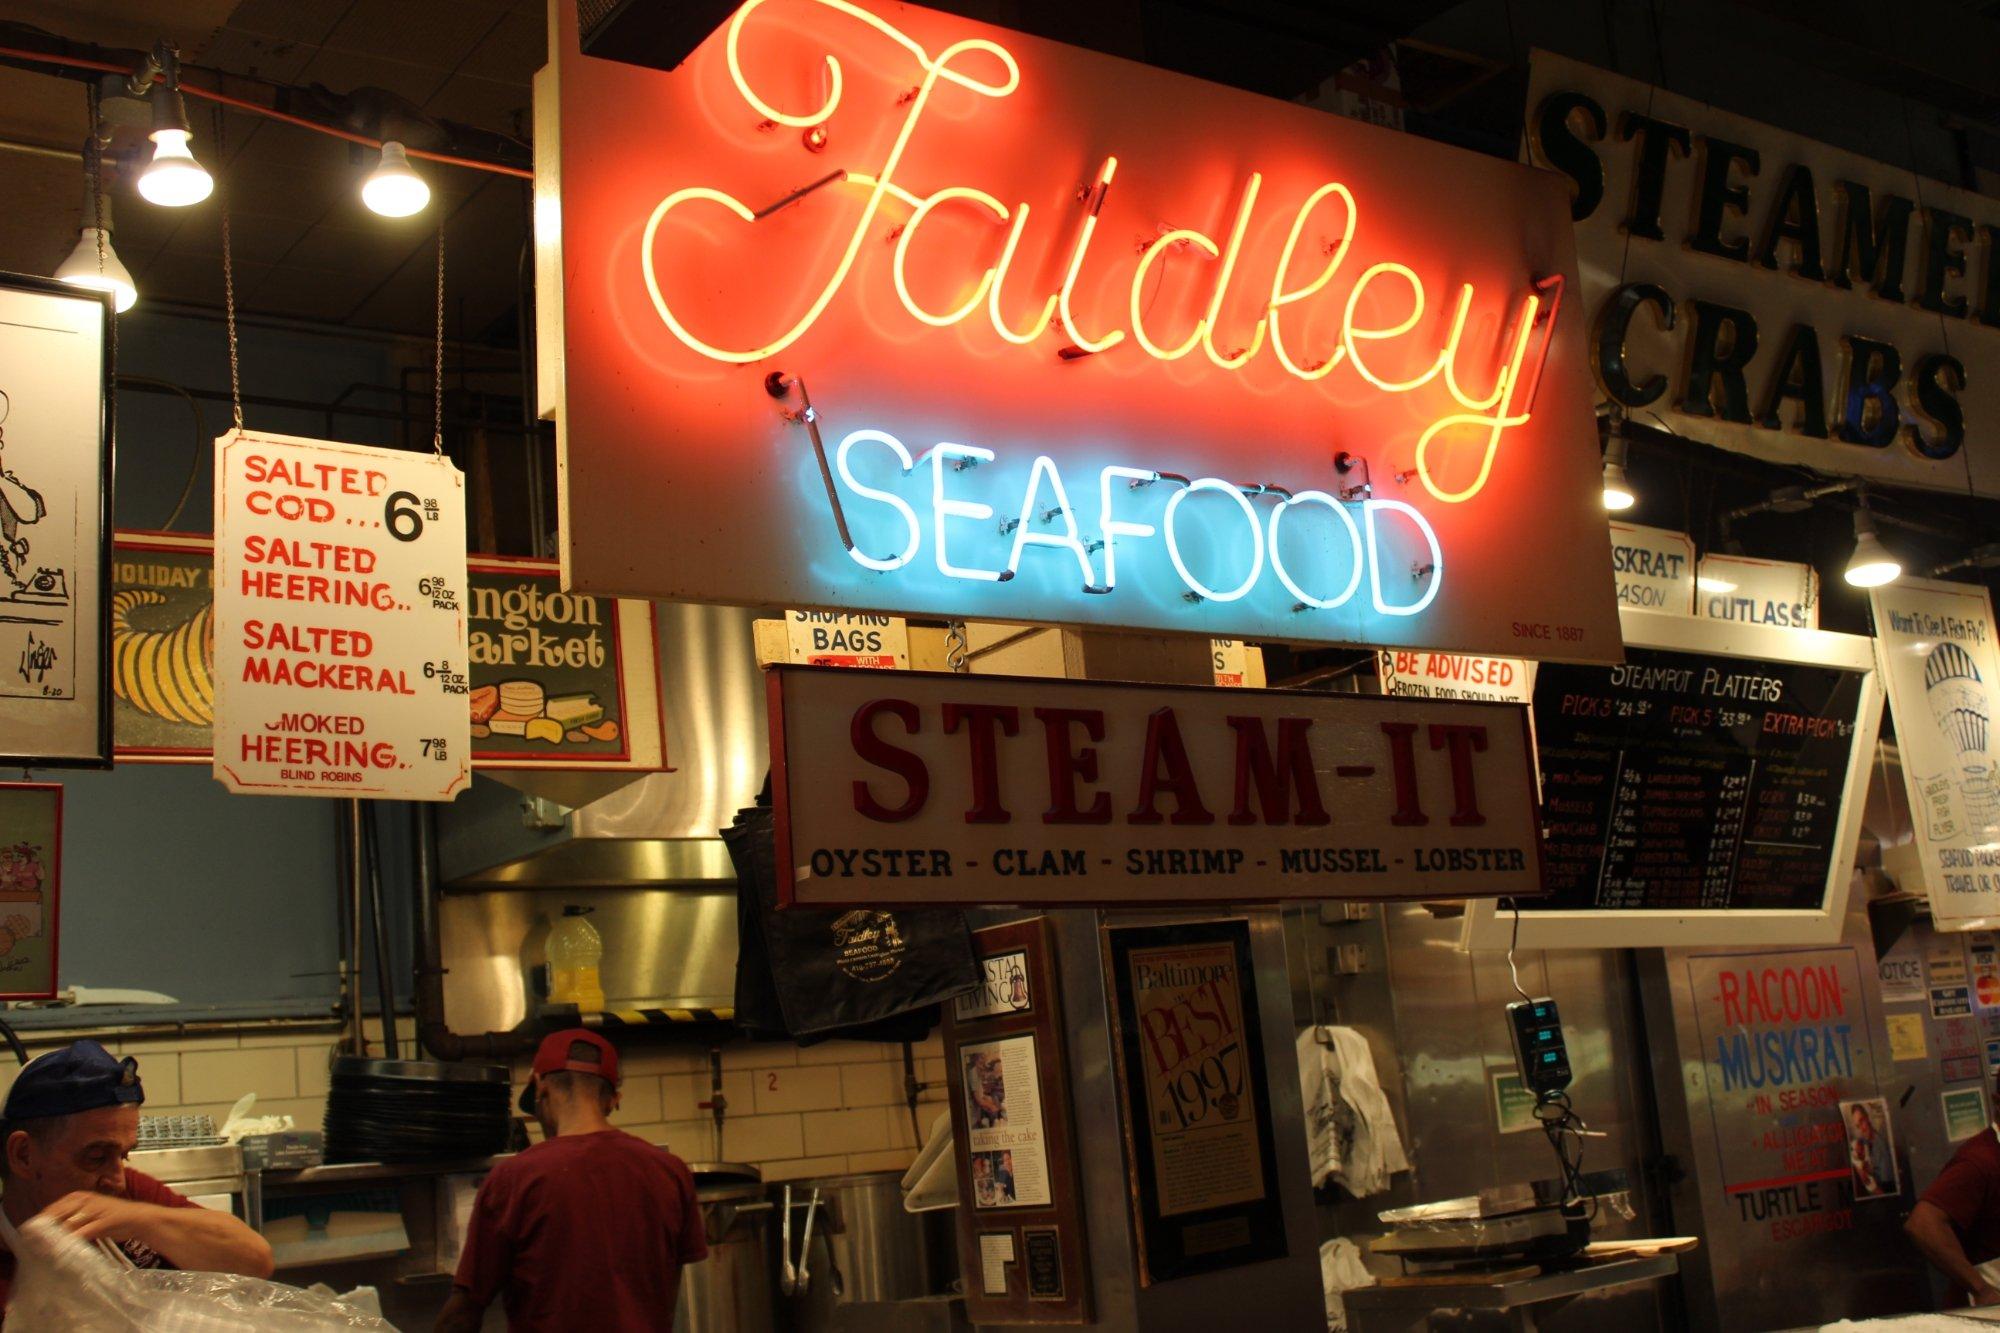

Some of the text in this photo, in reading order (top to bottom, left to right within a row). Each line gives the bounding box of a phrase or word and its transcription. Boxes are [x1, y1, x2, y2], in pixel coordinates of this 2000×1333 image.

[640, 0, 1541, 504] Faidley
[1591, 279, 1967, 461] CRABS
[244, 455, 388, 497] SALTED
[837, 428, 1444, 617] SEAFOOD
[243, 535, 377, 574] SALTED
[1612, 545, 1685, 580] SKRAT
[432, 600, 460, 611] PACK
[468, 583, 602, 630] ngton
[1708, 595, 1807, 630] CUTLASS
[242, 619, 374, 658] SALTED
[813, 627, 882, 652] BAGS
[1512, 622, 1584, 642] SINCE 1887
[241, 656, 416, 695] MACKERAL
[1396, 652, 1513, 688] BE ADVISED
[1610, 663, 1784, 703] STEAMPOT PLATTERS
[443, 685, 469, 695] PACK
[1561, 693, 1598, 717] PICK
[1763, 711, 1804, 736] EXTRA
[1806, 716, 1836, 740] PICK
[281, 769, 362, 783] BLIND ROBINS
[849, 698, 1490, 828] STEAM-IT
[811, 849, 952, 879] OYSTER
[992, 849, 1087, 877] CLAM
[1126, 848, 1245, 876] SHRIMP
[1280, 848, 1387, 875] MUSSEL
[1415, 847, 1526, 874] LOBSTER
[1136, 962, 1232, 991] Baltimore
[1718, 964, 1846, 1027] RACOON
[1141, 973, 1236, 1077] BEST
[1716, 1024, 1853, 1092] MUSKRAT
[1162, 1042, 1243, 1128] 1997
[1755, 1085, 1840, 1114] IN SEASON
[1001, 1131, 1015, 1143] the
[1018, 1128, 1038, 1142] cake
[1734, 1181, 1823, 1222] TURTLE
